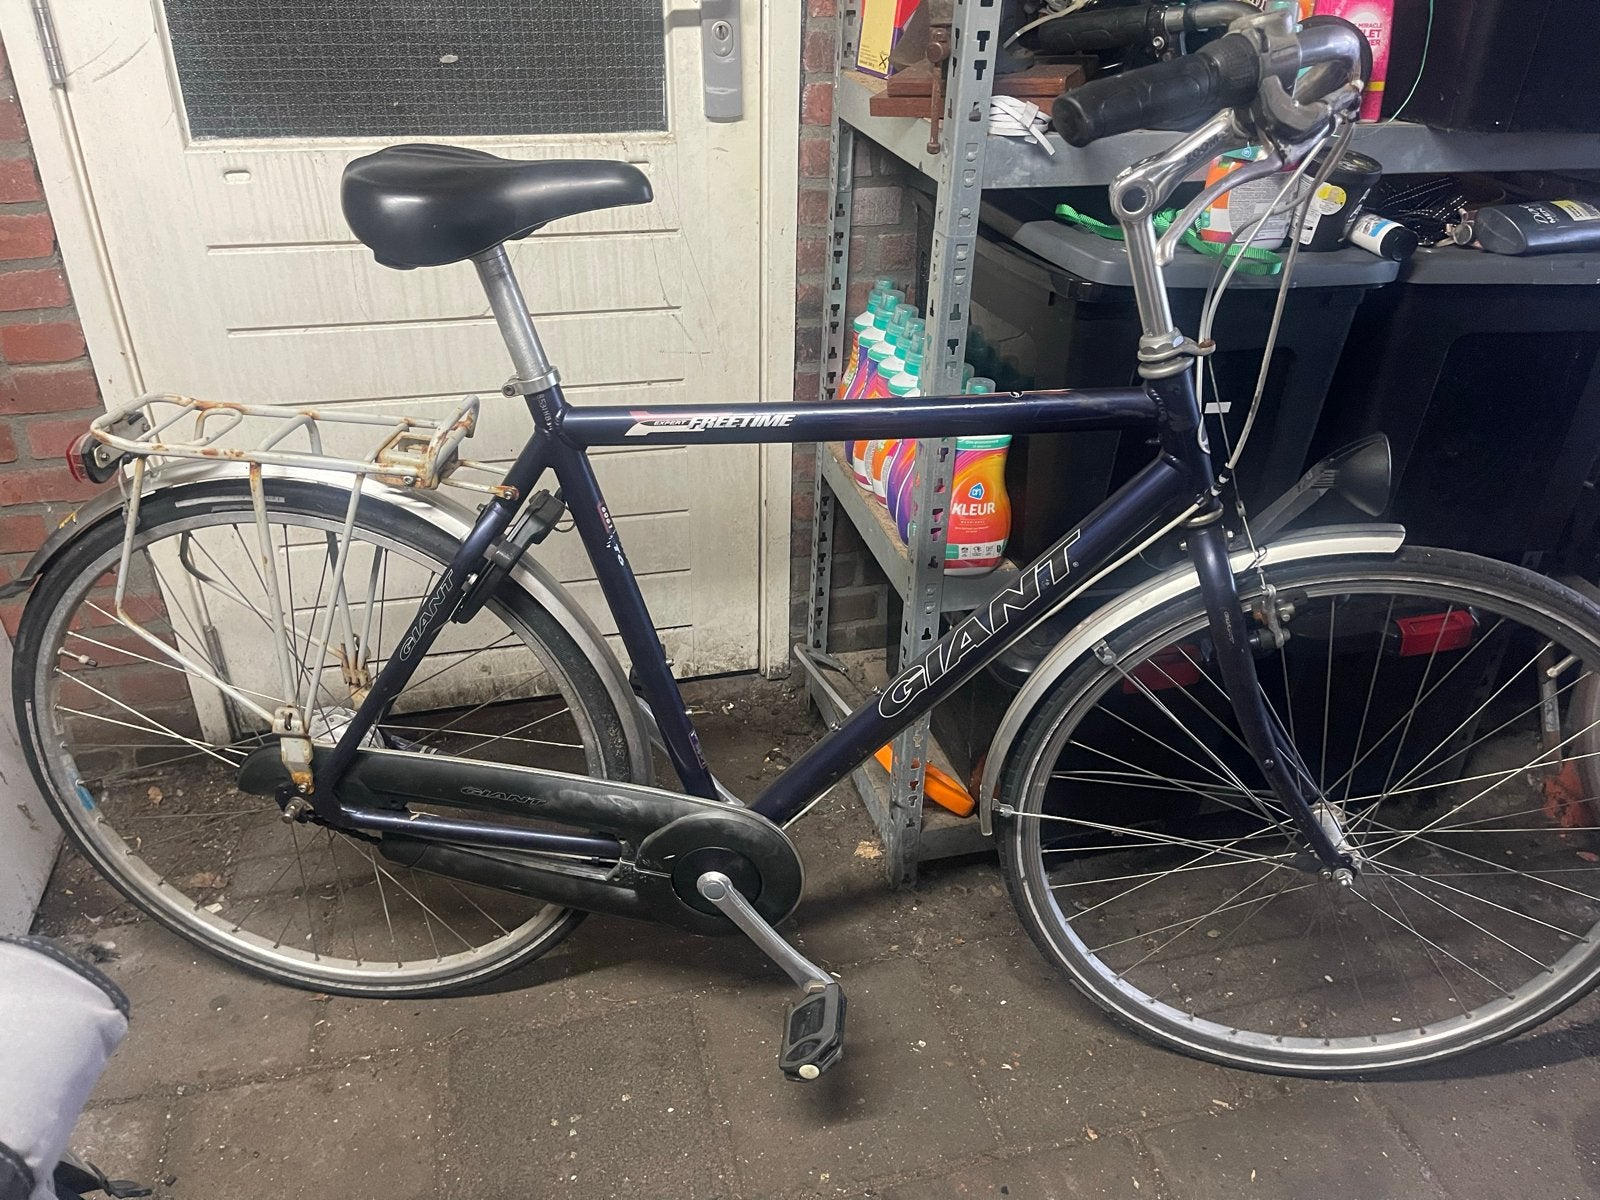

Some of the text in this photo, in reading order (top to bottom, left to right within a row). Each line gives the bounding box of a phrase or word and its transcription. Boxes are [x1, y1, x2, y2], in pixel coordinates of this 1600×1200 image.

[688, 414, 797, 429] FREETIME
[951, 501, 996, 516] KLEUR
[399, 568, 454, 662] GIANT
[878, 528, 1081, 718] GIANT
[460, 786, 547, 807] GIANT
